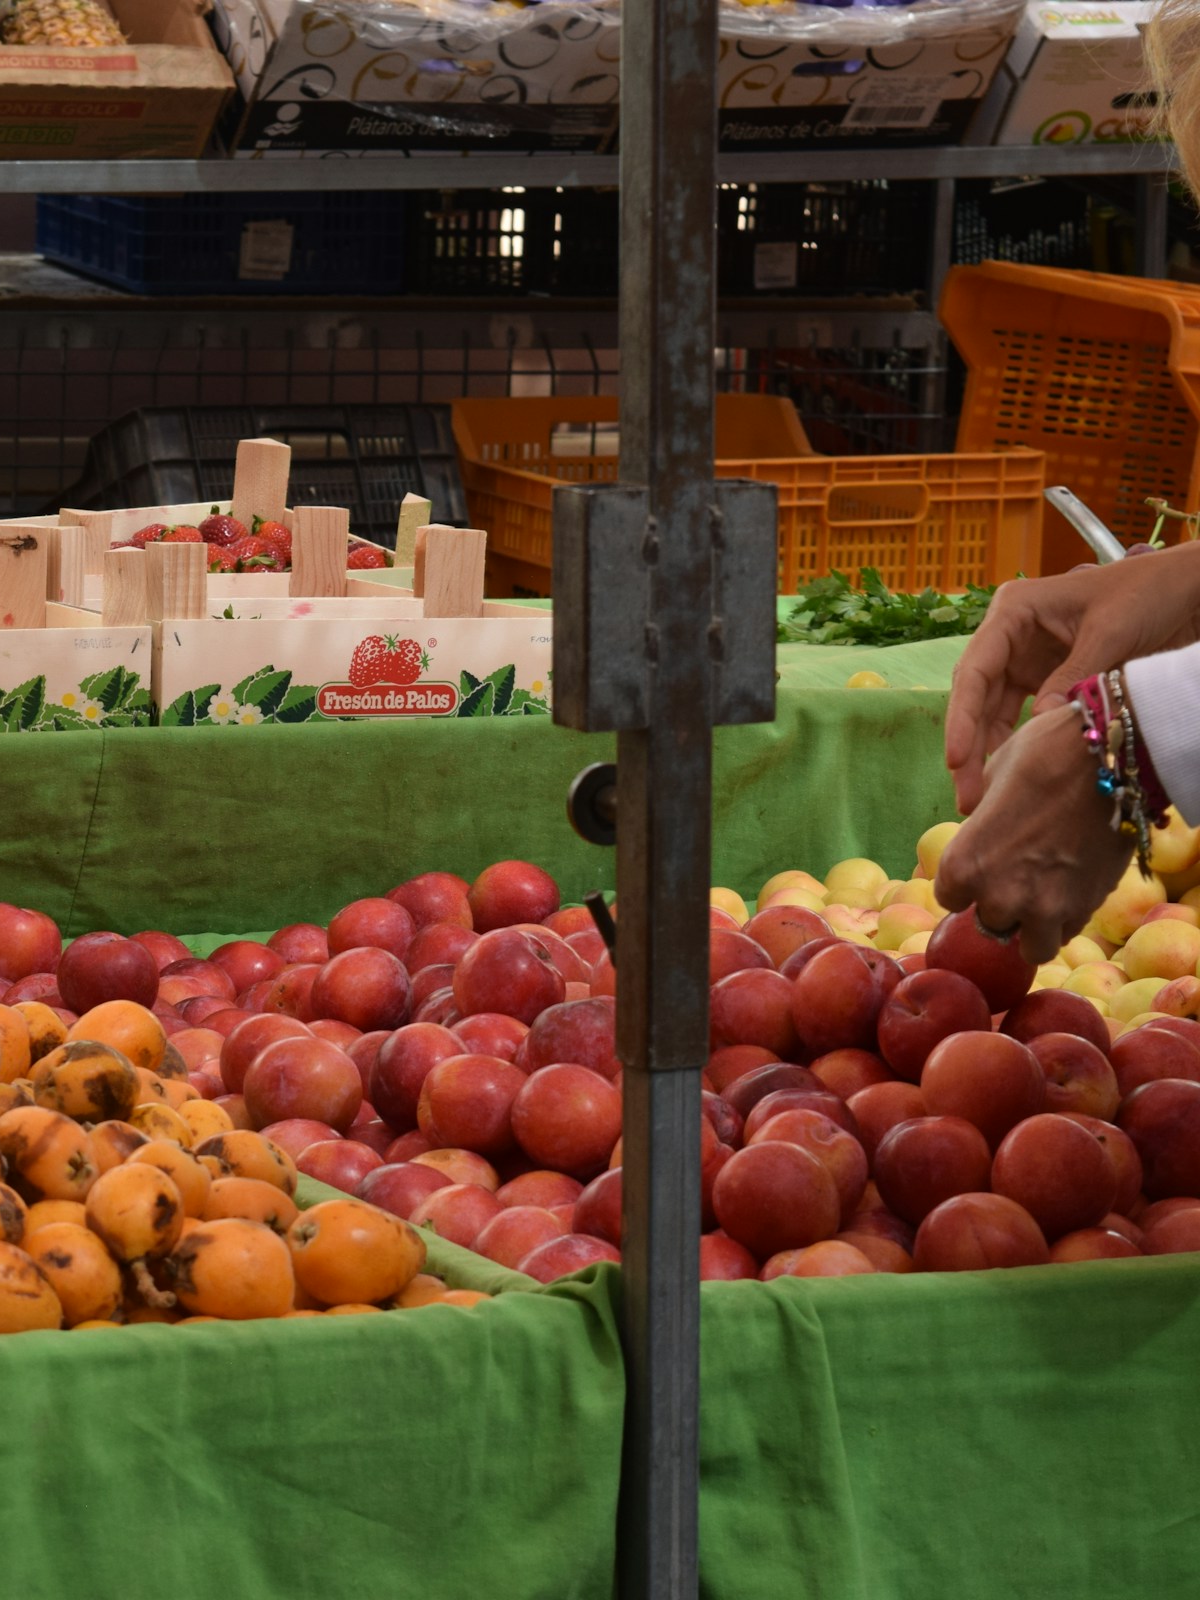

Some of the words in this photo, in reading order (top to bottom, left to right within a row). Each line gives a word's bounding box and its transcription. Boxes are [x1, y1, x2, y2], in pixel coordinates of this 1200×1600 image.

[55, 59, 95, 69] GOLD
[61, 102, 120, 116] GOLD
[346, 116, 416, 136] Plátanos
[720, 120, 785, 140] Plátanos
[789, 121, 811, 138] de
[323, 691, 382, 710] Fresón
[384, 690, 405, 709] de
[405, 690, 450, 709] Palos
